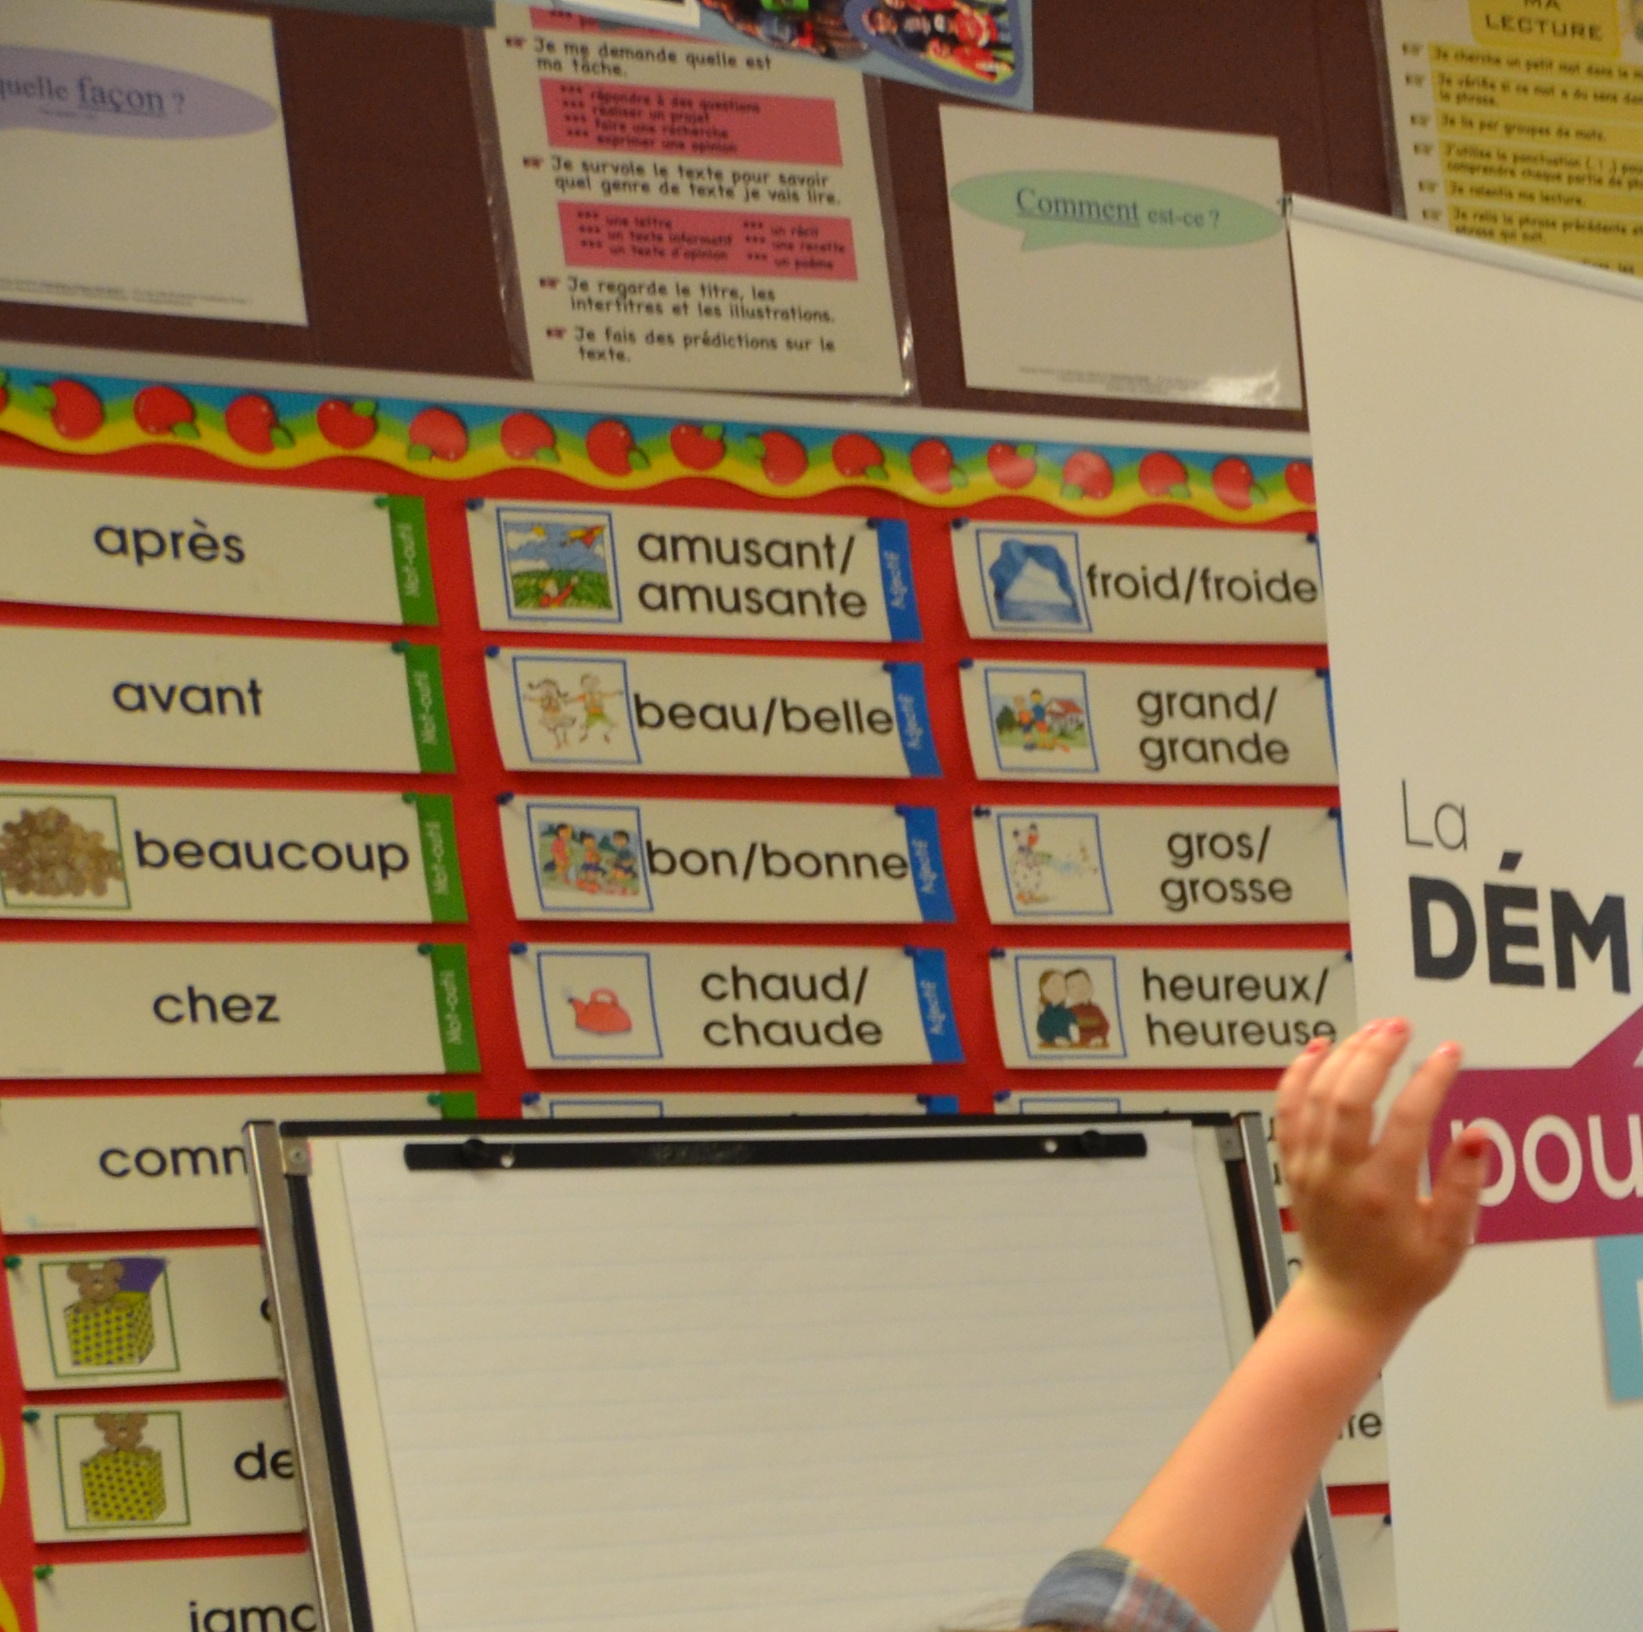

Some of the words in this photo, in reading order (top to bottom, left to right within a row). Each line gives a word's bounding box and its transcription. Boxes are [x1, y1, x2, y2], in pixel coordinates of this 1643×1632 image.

[1486, 14, 1603, 42] LECTURE
[535, 37, 556, 53] Je
[564, 44, 589, 55] me
[598, 42, 677, 62] demande
[686, 48, 737, 70] quelle
[746, 52, 771, 68] est
[537, 62, 563, 73] ma
[574, 59, 626, 76] tâche.
[77, 75, 165, 113] façon
[552, 156, 573, 172] Je
[582, 158, 645, 176] survole
[654, 162, 668, 177] le
[678, 163, 723, 180] texte
[732, 171, 768, 187] pour
[778, 169, 827, 186] savoir
[555, 174, 591, 194] quel
[601, 181, 650, 198] genre
[659, 180, 680, 195] de
[690, 182, 735, 198] texte
[745, 185, 760, 204] je
[768, 186, 799, 202] vais
[808, 188, 840, 204] lire.
[1017, 187, 1138, 221] Comment
[1147, 209, 1205, 228] est-ce
[568, 277, 589, 292] Je
[598, 278, 667, 300] regarde
[676, 282, 691, 297] le
[701, 283, 743, 300] titre,
[752, 285, 775, 300] les
[571, 297, 663, 315] intertitres
[672, 301, 689, 316] et
[698, 302, 721, 318] les
[730, 304, 835, 322] illustrations.
[575, 326, 595, 341] Je
[605, 327, 636, 343] fais
[683, 331, 777, 353] prédictions
[786, 339, 810, 350] sur
[820, 336, 835, 351] le
[580, 346, 630, 361] texte.
[94, 517, 246, 567] après
[638, 533, 855, 573] amusant/
[638, 577, 867, 618] amusante
[1086, 563, 1318, 605] froid/froide
[113, 678, 262, 716] avant
[634, 692, 894, 736] beau/belle
[1136, 686, 1278, 728] grand/
[1139, 732, 1290, 772] grande
[1402, 780, 1468, 850] La
[134, 831, 410, 881] beaucoup
[646, 837, 909, 881] bon/bonne
[1167, 825, 1271, 868] gros/
[1160, 877, 1292, 913] grosse
[152, 985, 280, 1024] chez
[700, 966, 869, 1006] chaud/
[1142, 966, 1329, 1005] heureux/
[703, 1013, 882, 1047] chaude
[1145, 1012, 1337, 1049] heureuse
